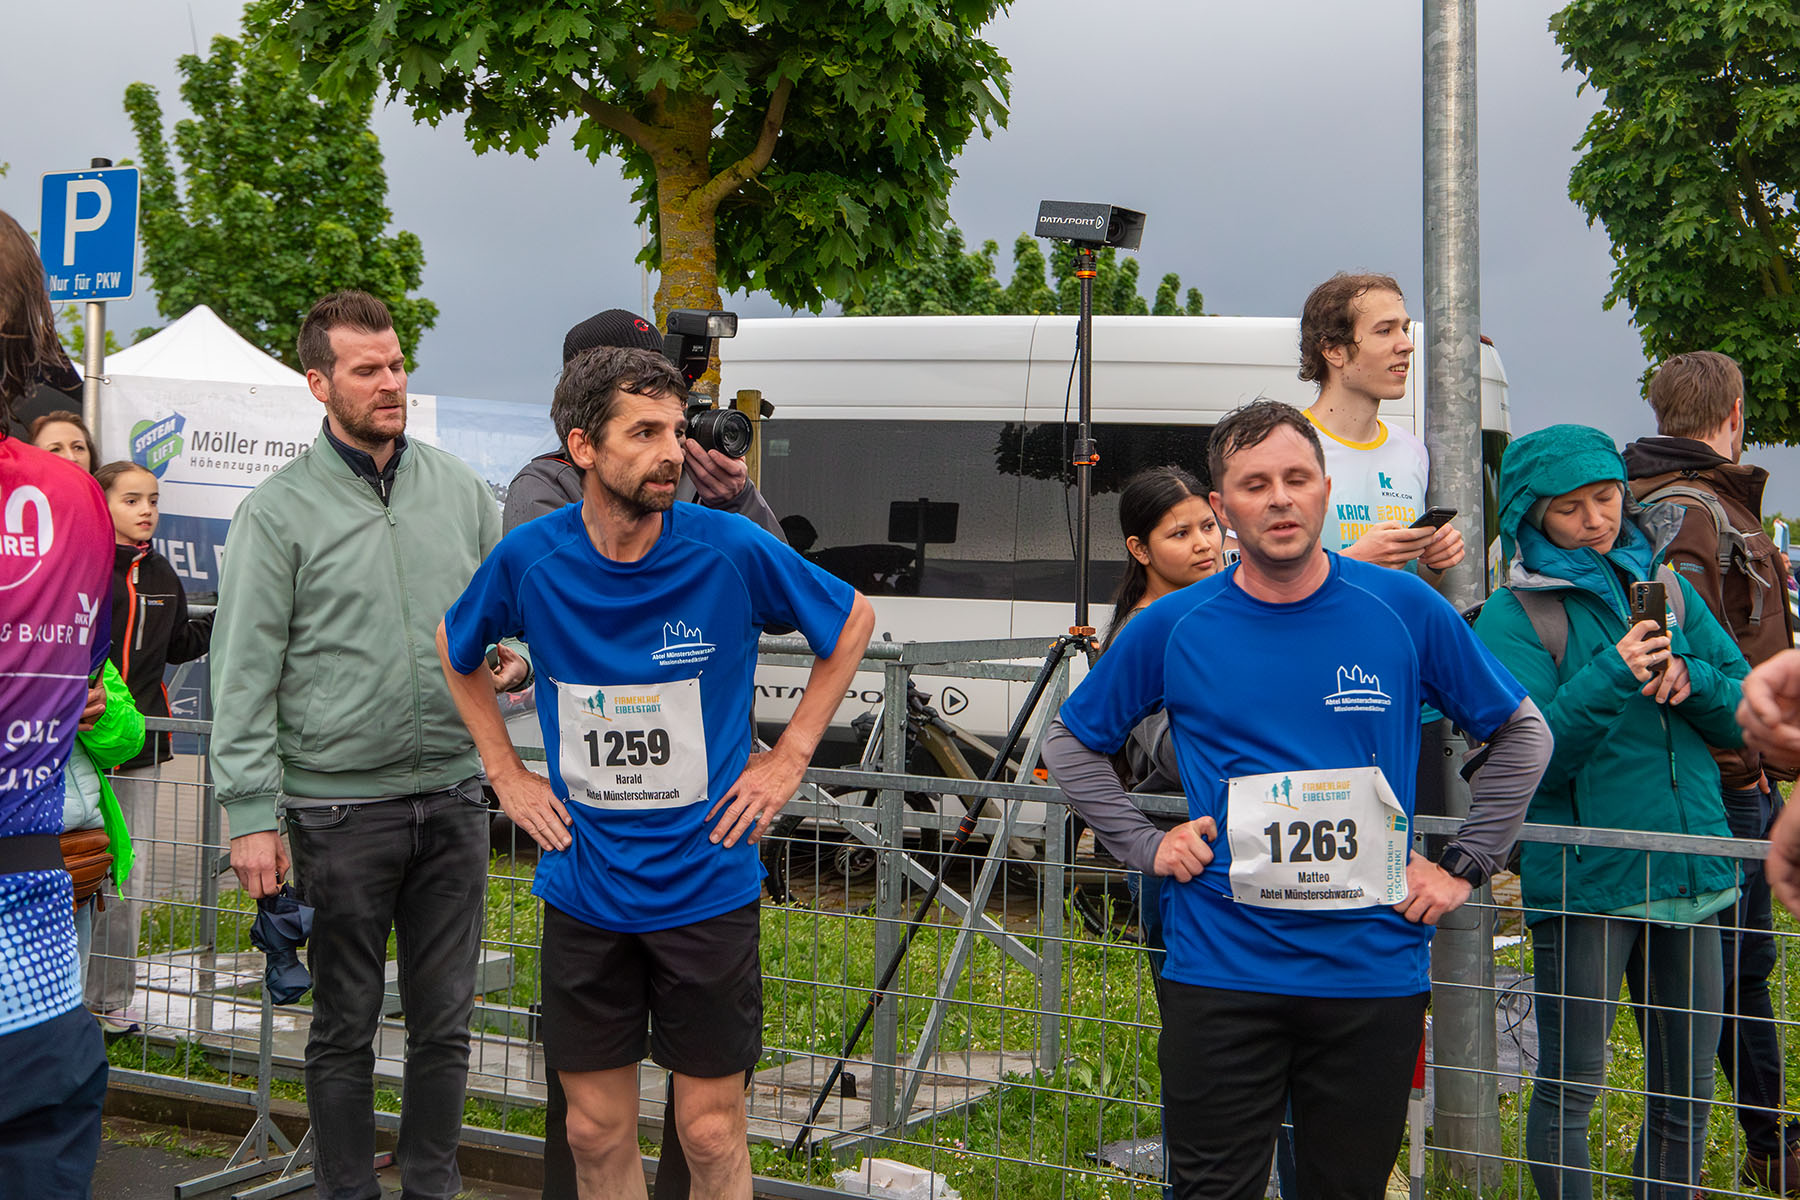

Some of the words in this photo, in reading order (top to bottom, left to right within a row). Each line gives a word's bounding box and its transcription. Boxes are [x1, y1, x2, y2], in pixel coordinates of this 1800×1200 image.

[63, 179, 112, 266] P
[1040, 216, 1095, 225] DATASPORT
[49, 275, 69, 291] Nur
[74, 273, 91, 290] für
[96, 272, 121, 289] PKW
[135, 418, 176, 453] SYSTEM
[191, 430, 258, 455] Möller
[152, 440, 176, 463] LIFT
[1336, 504, 1371, 521] KRICK
[1385, 504, 1416, 523] 2013
[0, 534, 36, 558] RE
[0, 623, 12, 642] &
[19, 623, 74, 645] BAUER
[614, 695, 661, 705] FIRMENLAUF
[615, 704, 662, 714] EIBELSTADT
[583, 728, 671, 767] 1259
[616, 774, 643, 785] Harald
[1302, 781, 1351, 792] FIRMENLAUF
[586, 788, 602, 801] Abtei
[603, 788, 680, 801] Münsterschwarzach
[1302, 791, 1351, 802] EIBELSTADT
[1263, 818, 1359, 864] 1263
[1298, 871, 1330, 883] Matteo
[1386, 864, 1394, 881] DIR
[1260, 888, 1283, 900] Abtei
[1284, 886, 1366, 900] Münsterschwarzach
[1386, 882, 1395, 902] HOL
